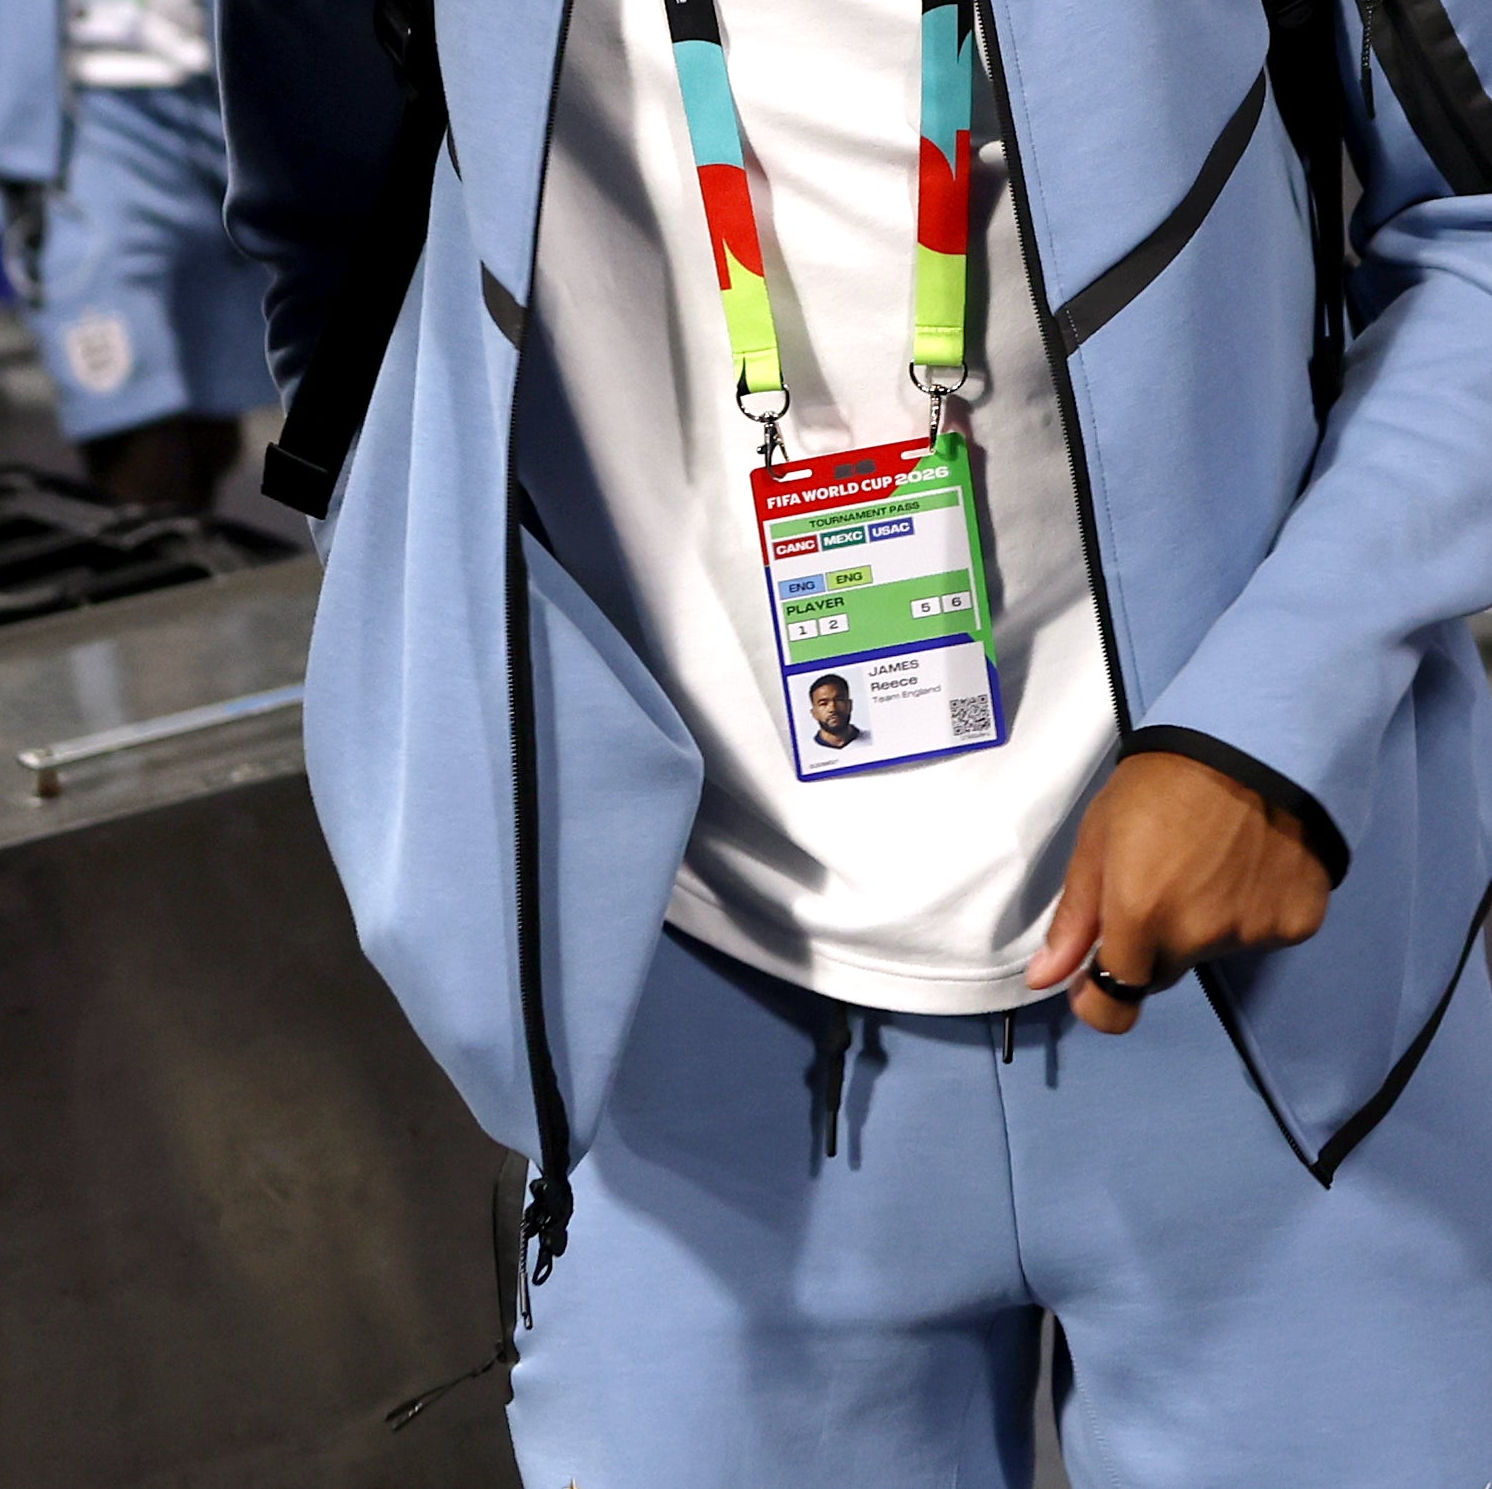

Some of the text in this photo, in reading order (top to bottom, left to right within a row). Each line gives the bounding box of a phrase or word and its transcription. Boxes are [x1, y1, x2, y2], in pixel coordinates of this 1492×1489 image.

[767, 493, 801, 509] FIFA
[802, 483, 859, 503] WORLD
[861, 476, 893, 492] CUP
[895, 466, 949, 486] 2026
[809, 501, 920, 528] TOURNAMENT PASS
[776, 522, 910, 555] CANC MEXC USAC
[789, 572, 863, 593] ENG ENG
[786, 597, 845, 616] PLAYER
[799, 597, 962, 635] 1 2 5 6
[868, 659, 919, 677] JAMES
[871, 676, 918, 692] Reece
[872, 685, 941, 703] Team England
